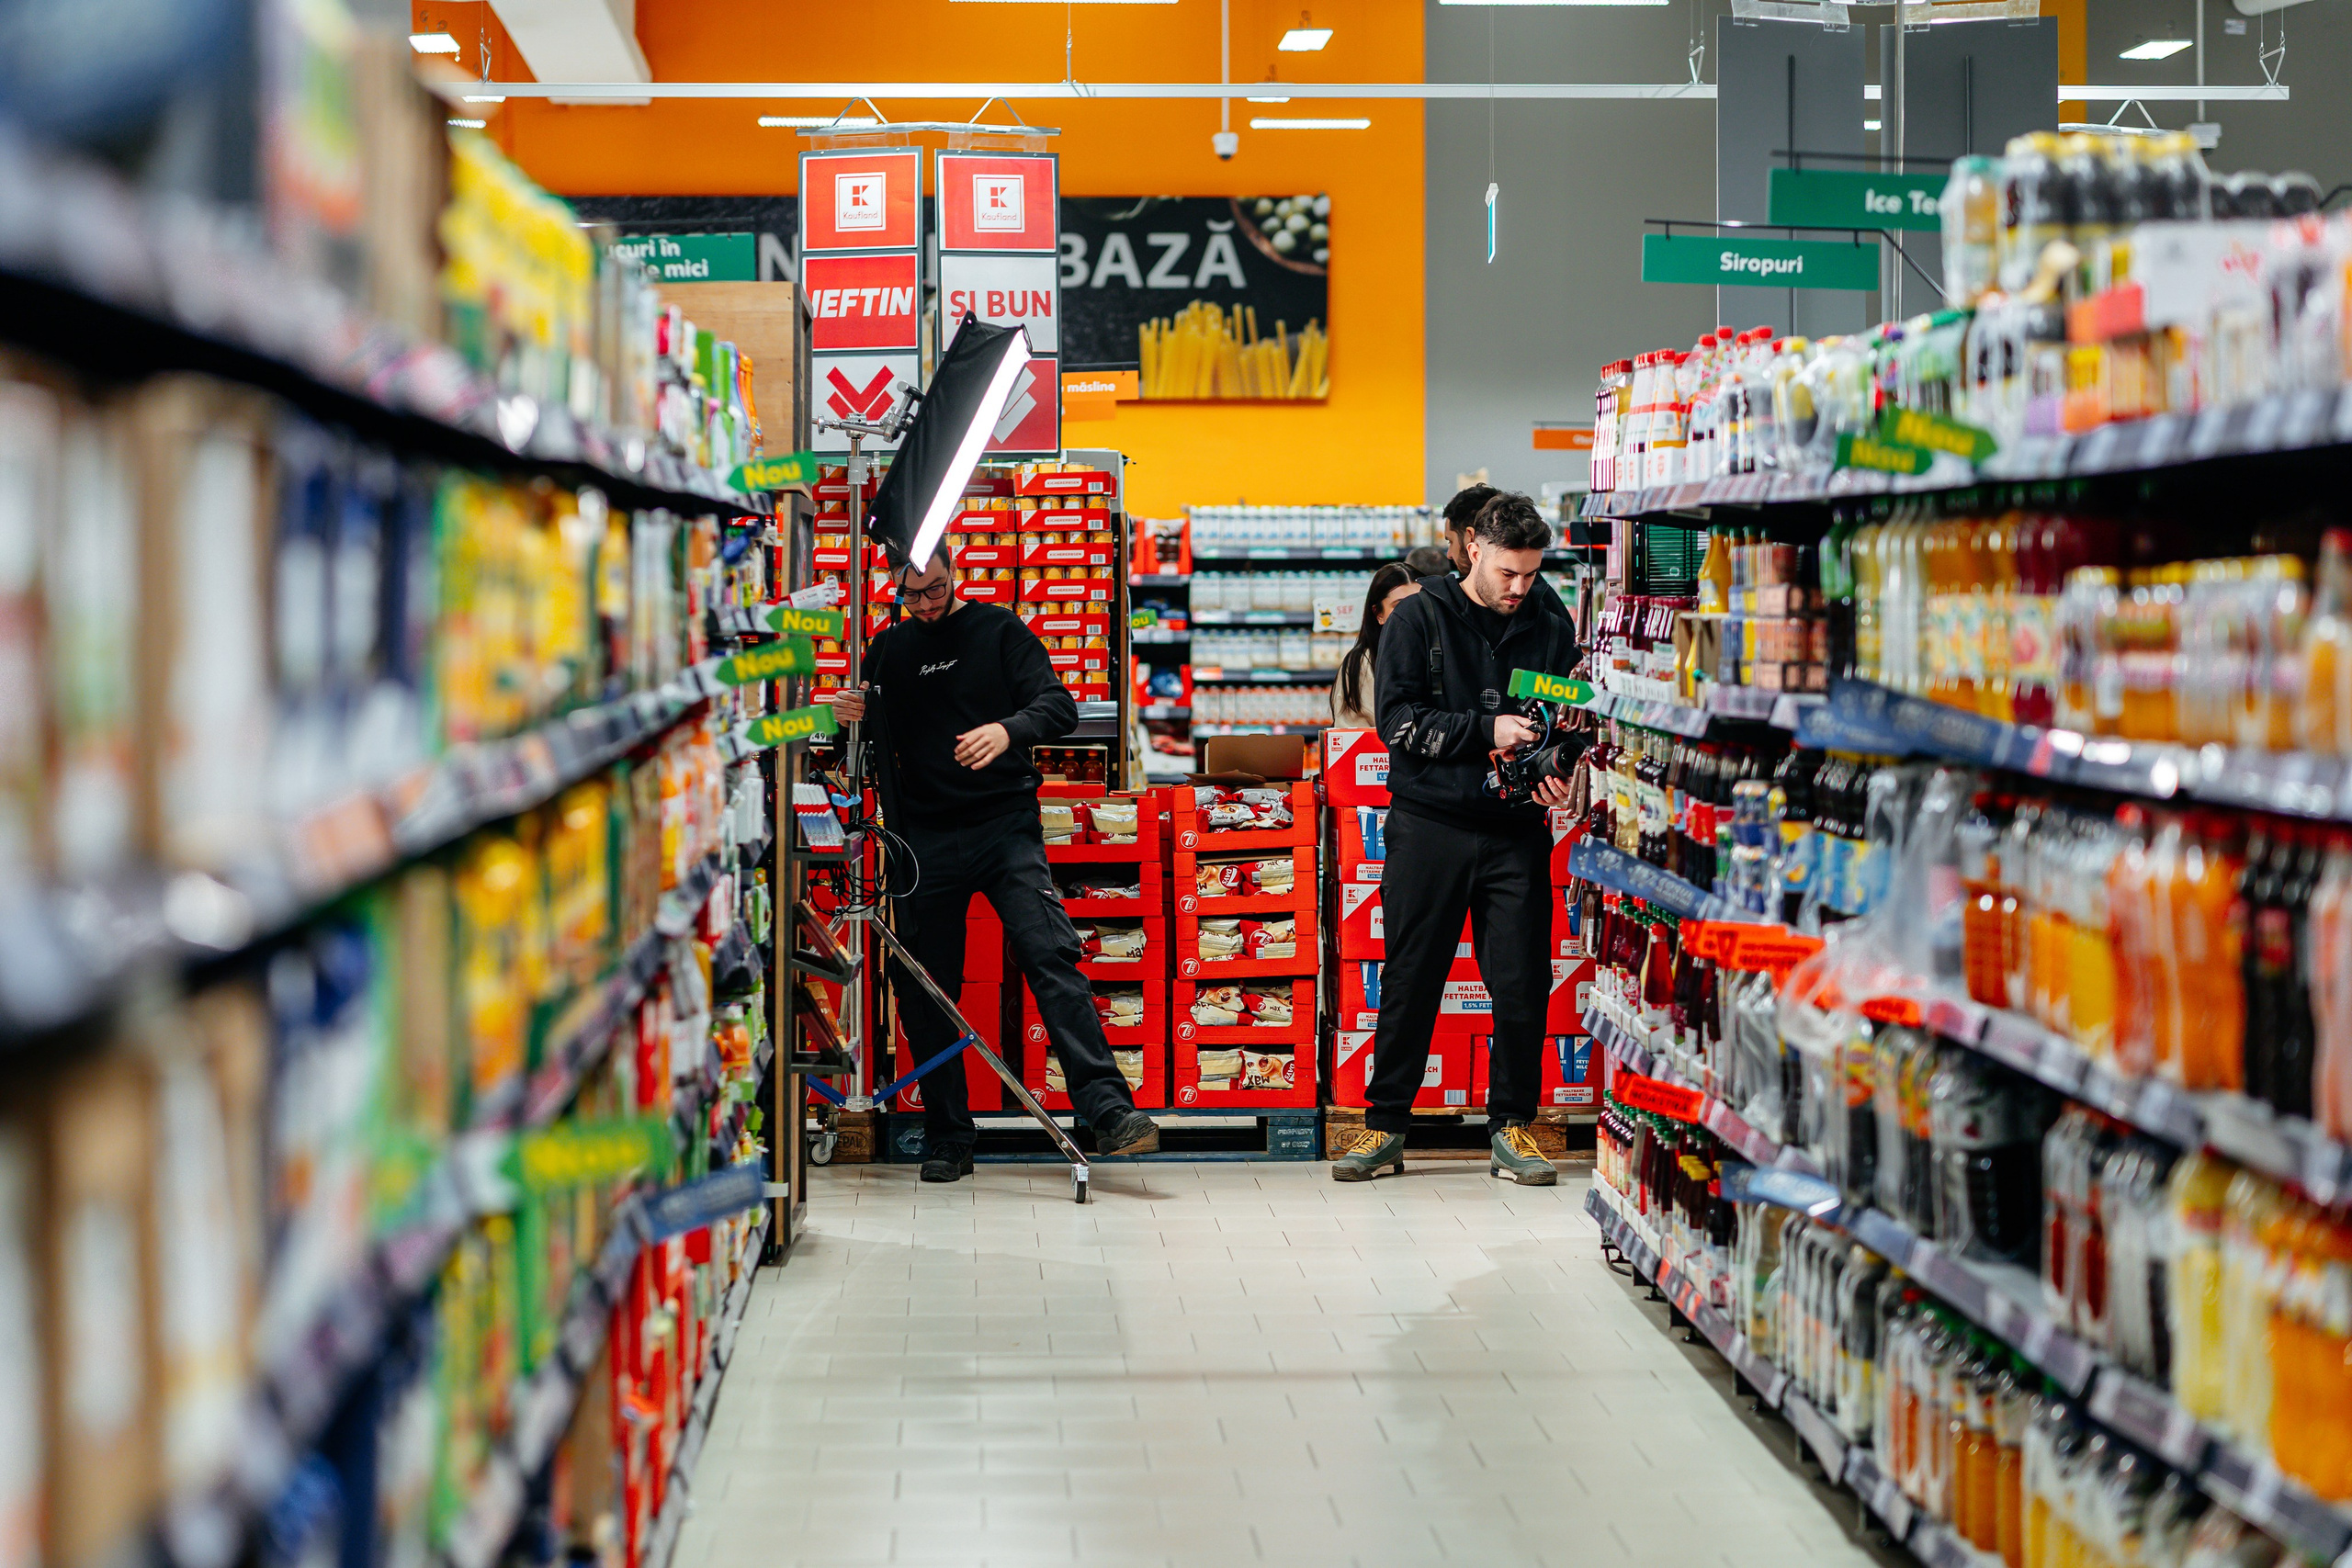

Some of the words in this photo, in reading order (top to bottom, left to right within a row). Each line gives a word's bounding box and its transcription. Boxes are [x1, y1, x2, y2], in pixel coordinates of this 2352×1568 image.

[1865, 188, 1903, 214] Ice
[1907, 189, 1941, 215] Te
[842, 211, 878, 220] Kaufland
[981, 212, 1017, 221] Kaufland
[1060, 219, 1247, 289] BAZĂ
[1719, 252, 1804, 276] Siropuri
[663, 259, 709, 277] mici
[987, 290, 1052, 318] BUN
[742, 461, 802, 490] Nou
[782, 609, 831, 632] Nou
[1131, 615, 1149, 626] ou
[733, 648, 796, 682] Nou
[1533, 674, 1579, 700] Nou
[761, 716, 816, 741] Nou
